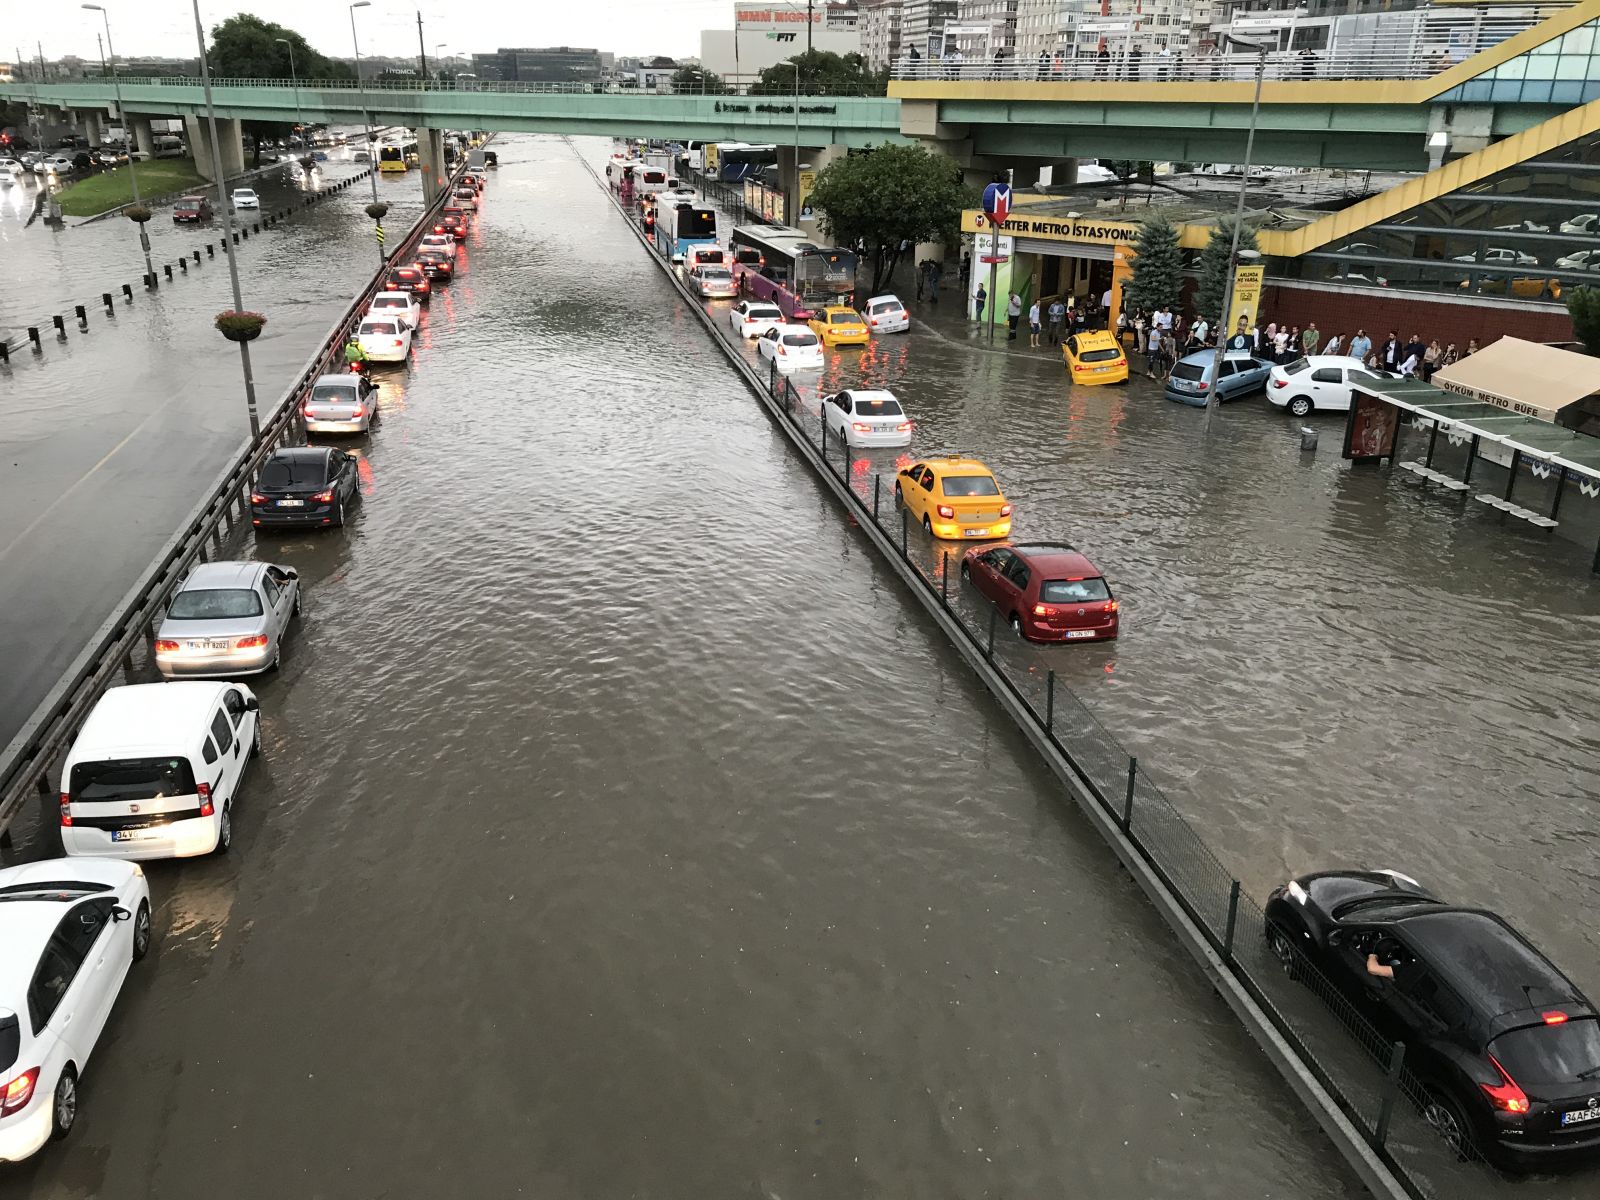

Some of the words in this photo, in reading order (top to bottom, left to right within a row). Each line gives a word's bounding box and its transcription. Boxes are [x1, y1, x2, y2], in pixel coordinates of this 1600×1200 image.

[1032, 222, 1069, 235] METRO
[985, 239, 1008, 250] Gnti
[1443, 380, 1474, 398] ÖYKÜM
[1478, 392, 1509, 408] METRO
[1514, 402, 1539, 417] BÜFE
[116, 831, 128, 839] 34
